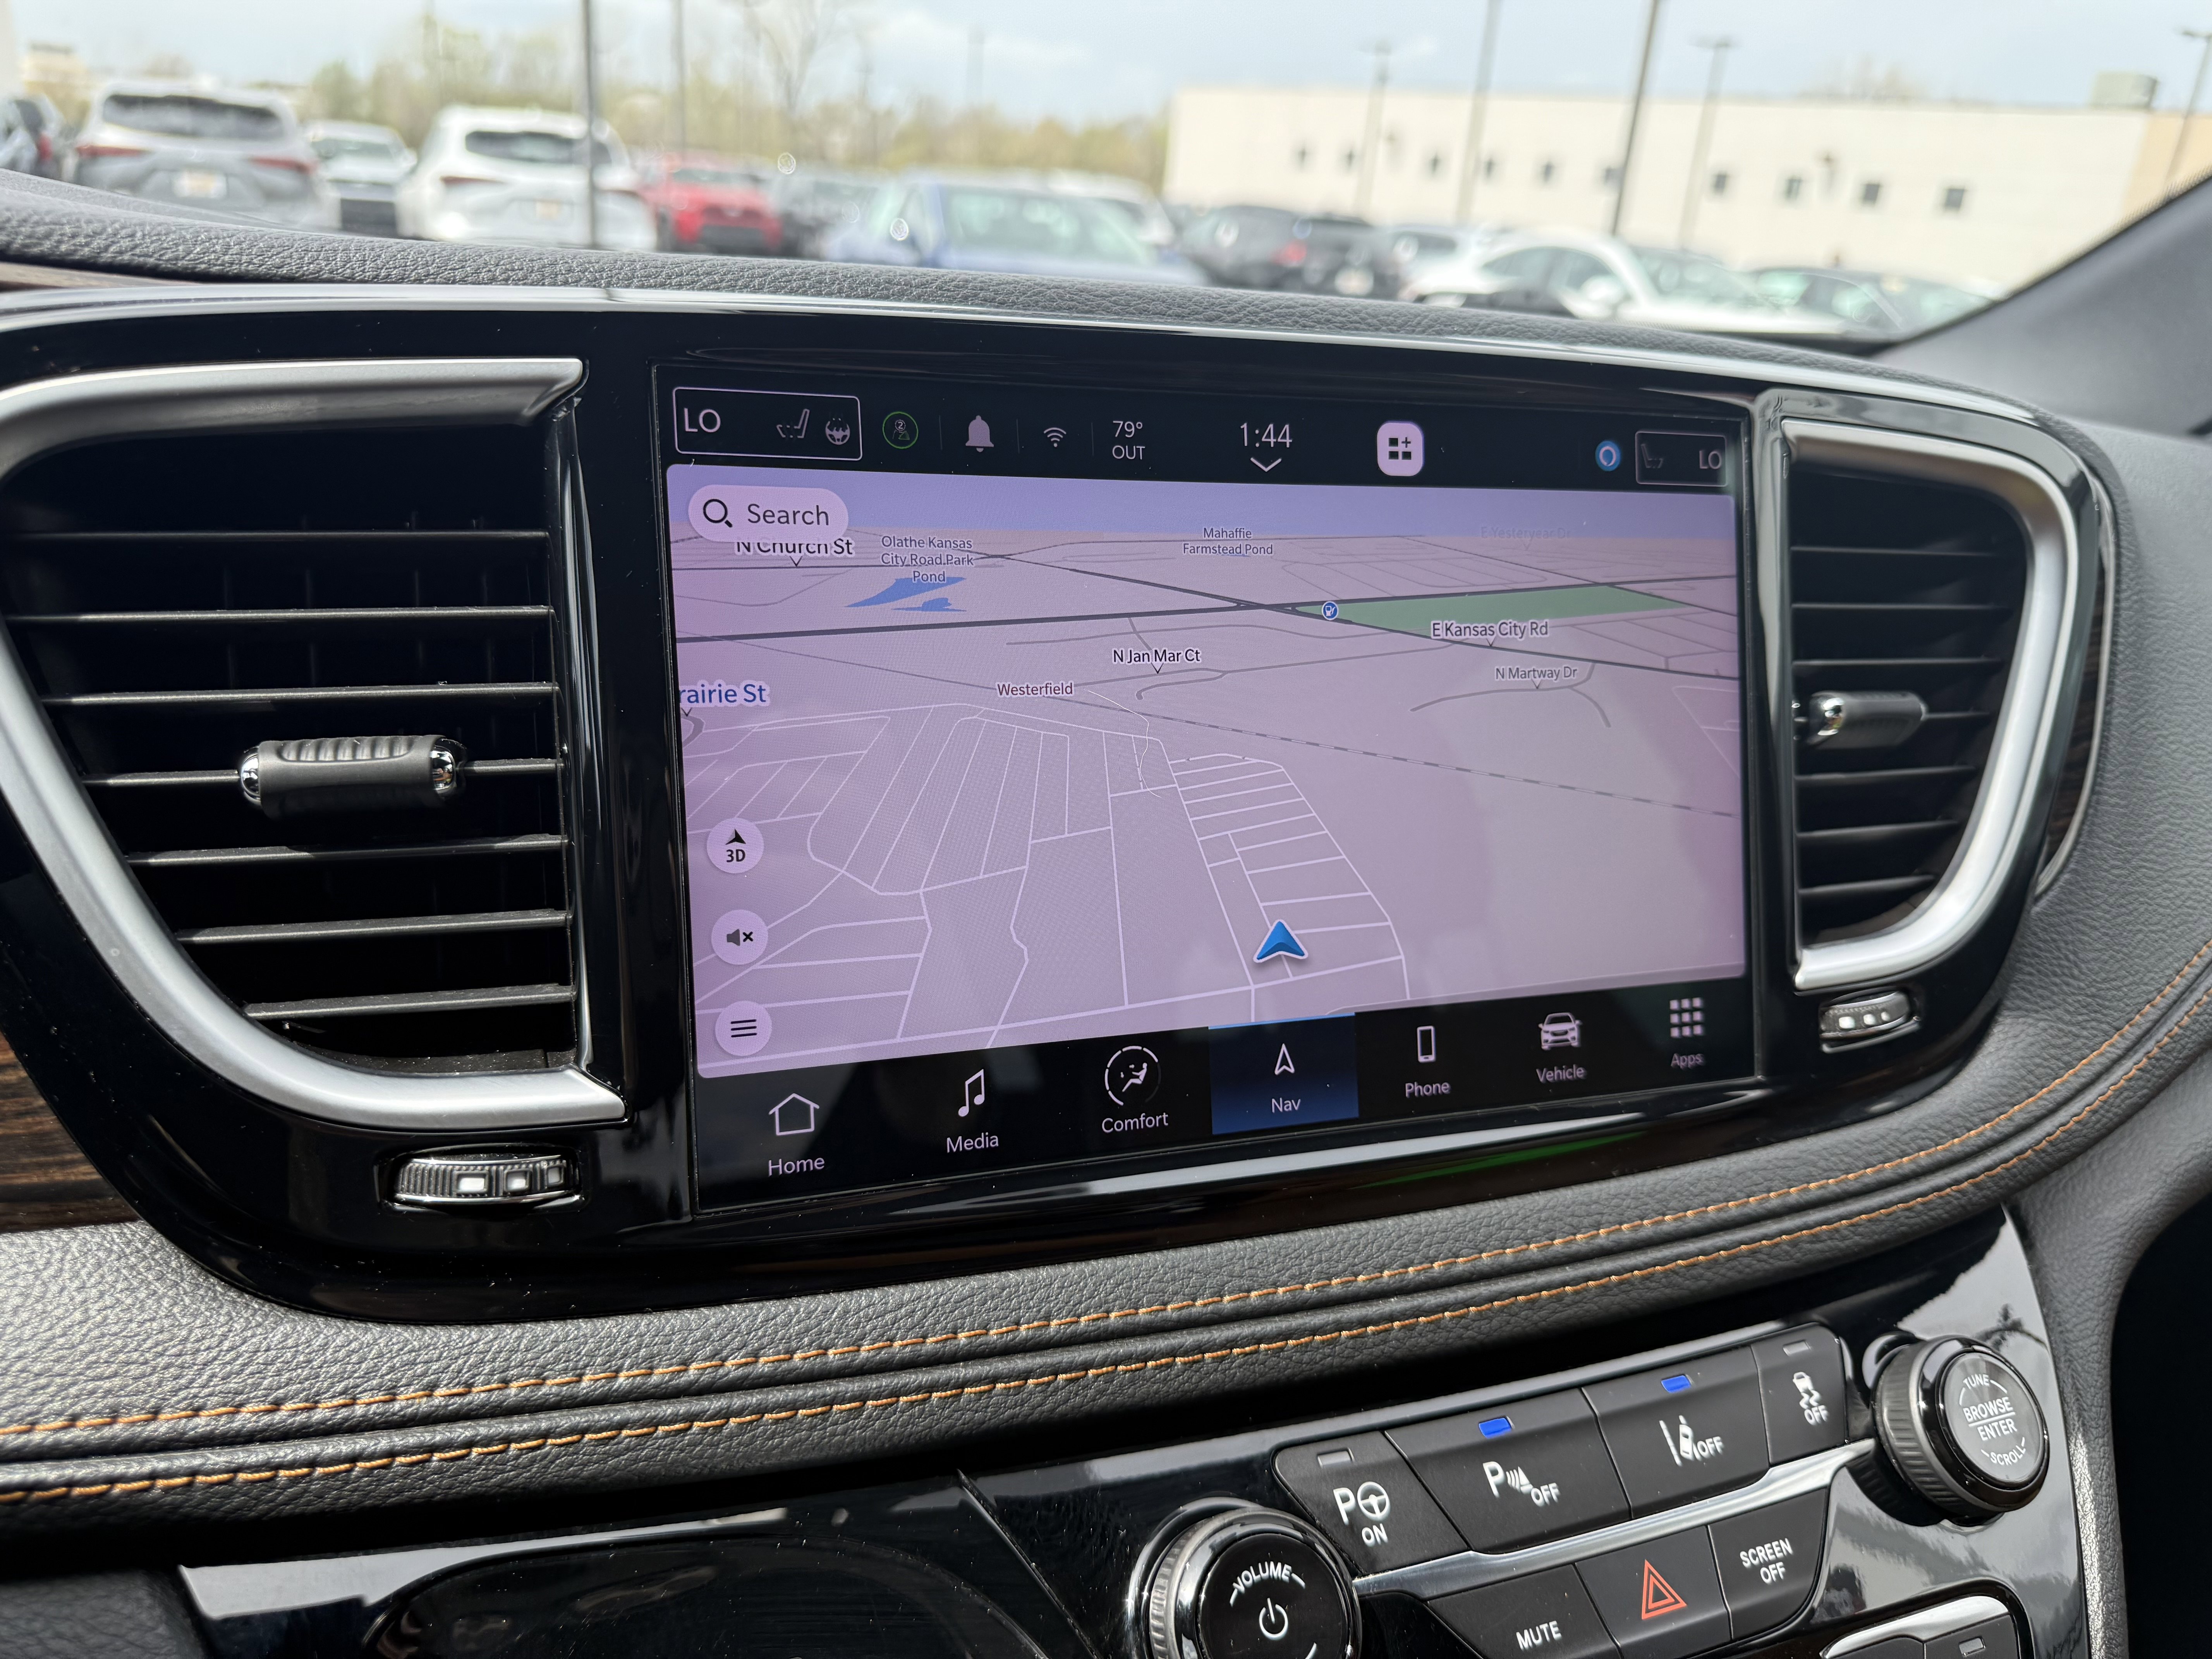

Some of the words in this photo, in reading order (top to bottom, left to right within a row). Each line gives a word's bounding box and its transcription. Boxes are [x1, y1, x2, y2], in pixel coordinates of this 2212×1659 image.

[684, 408, 721, 433] LO
[1113, 421, 1143, 438] 79°
[1240, 423, 1293, 448] 1:44
[1112, 445, 1145, 460] OUT
[1699, 450, 1722, 470] LO
[747, 503, 830, 526] Search
[881, 536, 924, 548] Olathe
[928, 537, 972, 549] Kansas
[1203, 527, 1252, 540] Mahaffie
[737, 542, 750, 553] N
[757, 542, 828, 555] Church
[833, 539, 852, 555] St
[1183, 543, 1242, 555] Farmstead
[1245, 543, 1273, 555] Pond
[881, 554, 907, 567] City
[910, 554, 942, 565] Road
[946, 555, 974, 566] Park
[913, 572, 946, 582] Pond
[1433, 623, 1441, 636] E
[1445, 622, 1495, 637] Kansas
[1499, 622, 1526, 639] City
[1530, 621, 1548, 635] Rd
[1113, 650, 1124, 663] N
[1127, 650, 1150, 663] Jan
[1155, 649, 1181, 662] Mar
[1185, 649, 1200, 662] Ct
[1496, 668, 1504, 679] N
[1508, 667, 1560, 682] Martway
[1564, 667, 1577, 678] Dr
[744, 684, 766, 703] St
[997, 683, 1073, 696] Westerfield
[726, 849, 745, 862] 3D
[1671, 1053, 1703, 1070] Apps
[1536, 1064, 1586, 1083] Vehicle
[1405, 1081, 1450, 1098] Phone
[1271, 1098, 1301, 1113] Nav
[1102, 1112, 1168, 1134] Comfort
[946, 1132, 999, 1153] Media
[768, 1156, 825, 1177] Home
[1963, 1374, 1990, 1390] TUNE
[1804, 1405, 1829, 1426] OFF
[1963, 1397, 2013, 1422] BROWSE
[1977, 1418, 2017, 1441] ENTER
[1697, 1436, 1723, 1456] OFF
[1990, 1446, 2026, 1466] SCROLL
[1483, 1461, 1506, 1498] P
[1530, 1482, 1561, 1506] OFF
[1333, 1487, 1356, 1525] P
[1362, 1523, 1388, 1547] ON
[1739, 1538, 1792, 1568] SCREEN
[1233, 1561, 1292, 1594] VOLUME
[1760, 1562, 1785, 1584] OFF
[1515, 1620, 1562, 1650] MUTE
